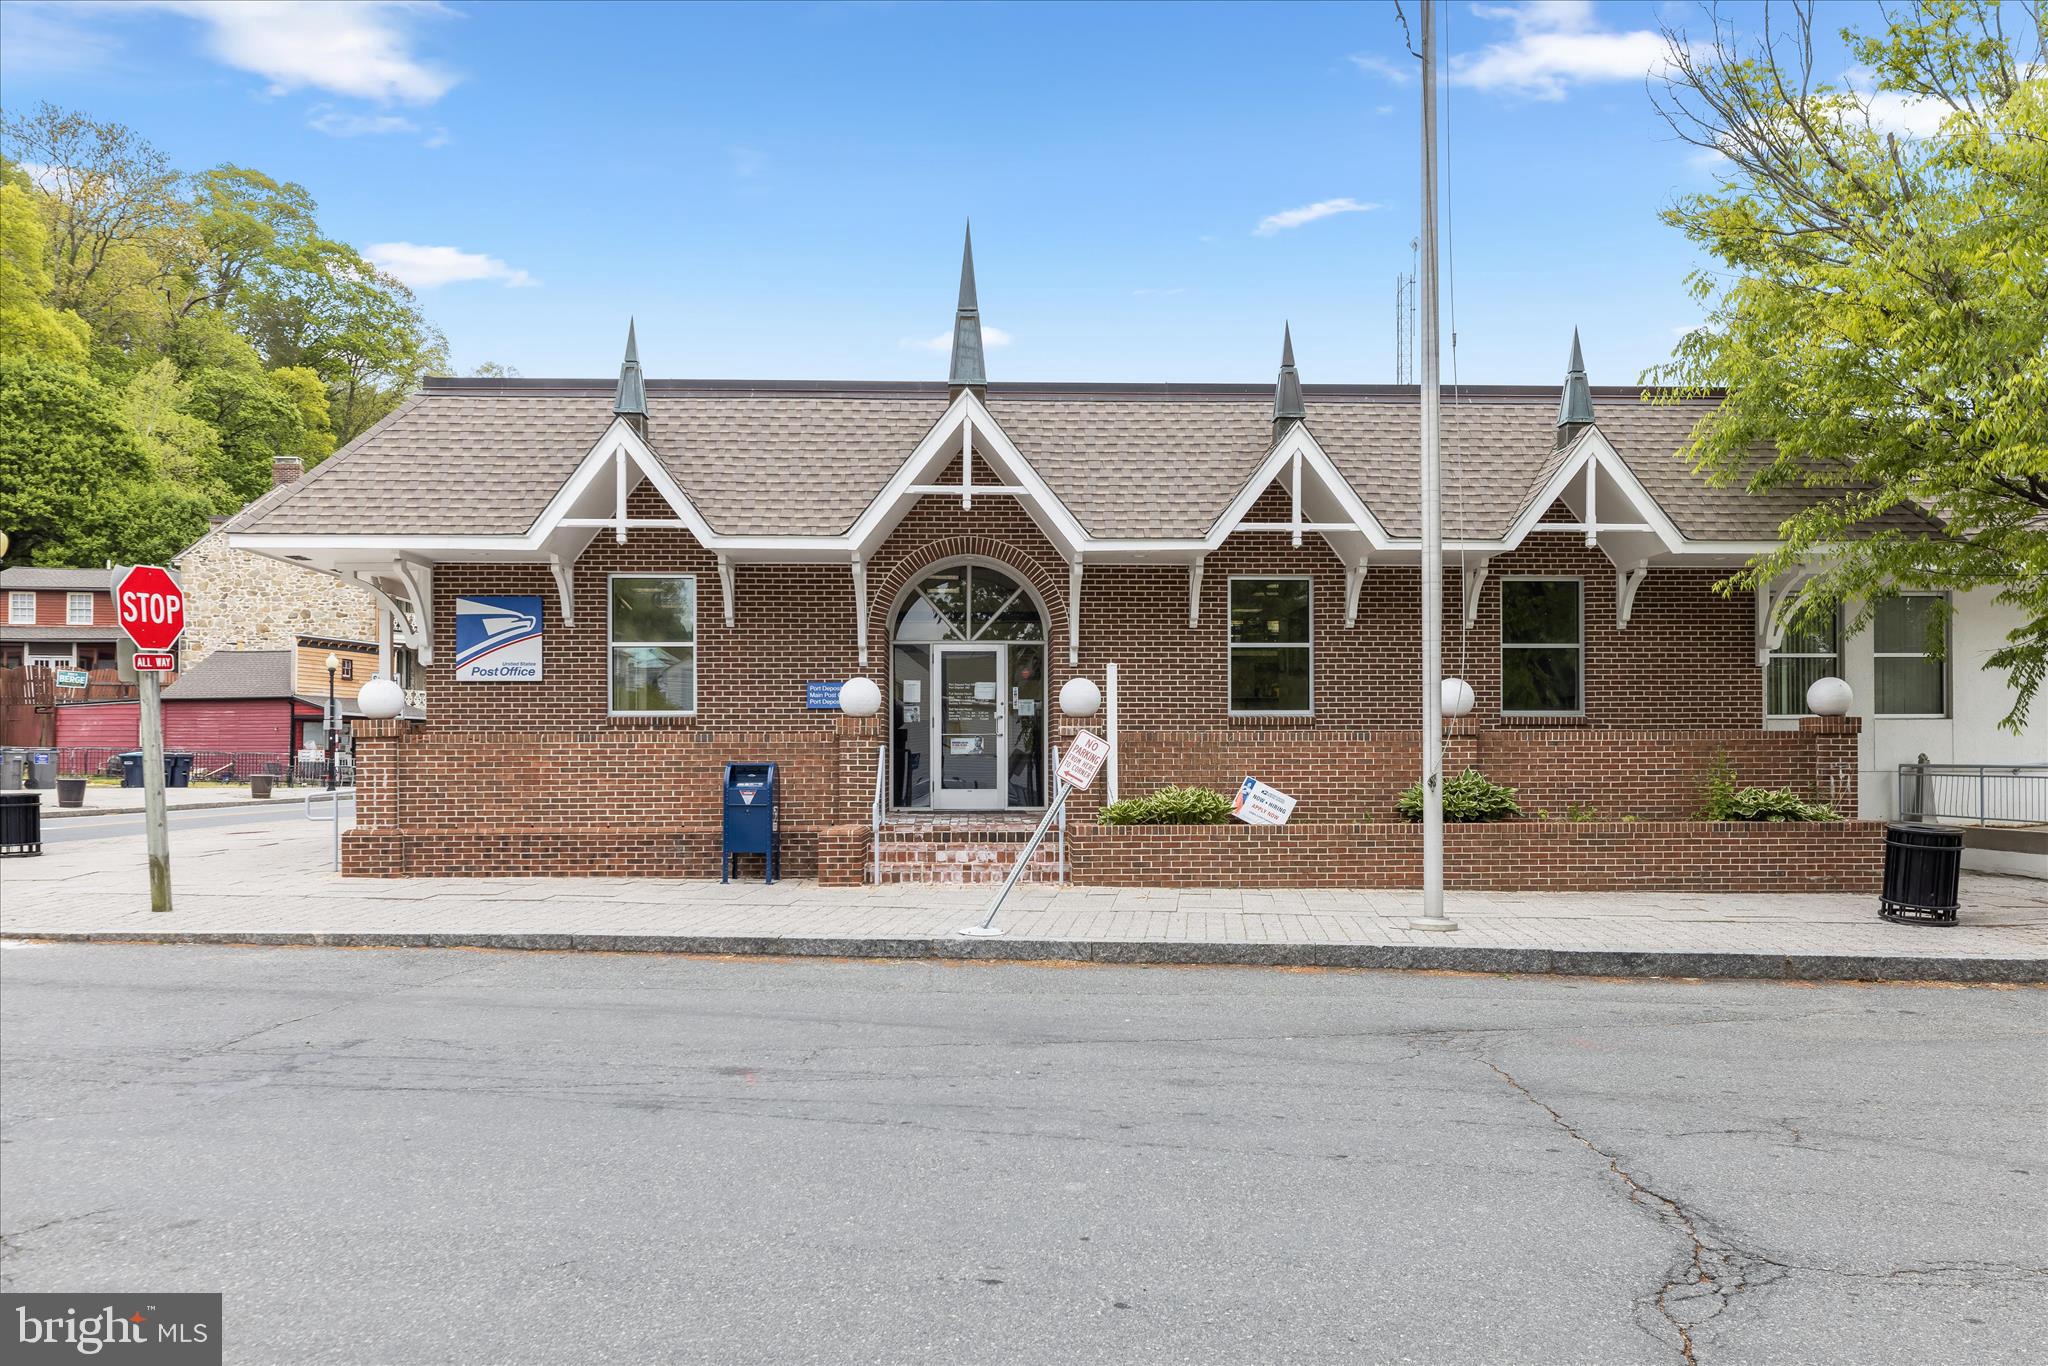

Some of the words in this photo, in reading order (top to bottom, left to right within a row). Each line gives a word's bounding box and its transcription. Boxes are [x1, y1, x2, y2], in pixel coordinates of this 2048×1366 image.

[123, 591, 180, 624] STOP
[137, 657, 152, 667] ALL
[155, 657, 171, 667] WAY
[59, 674, 86, 684] BERGE
[471, 666, 498, 677] Post
[500, 666, 536, 677] Office
[1085, 738, 1099, 751] NO
[1067, 753, 1082, 764] FROM
[1082, 761, 1096, 772] HERE
[1072, 744, 1101, 765] PARKING
[1064, 760, 1071, 768] TO
[1071, 764, 1092, 778] CORNER
[1251, 803, 1267, 814] APPLY
[1267, 811, 1280, 820] NOW
[1252, 794, 1265, 803] NOW
[1268, 802, 1287, 814] HIRING
